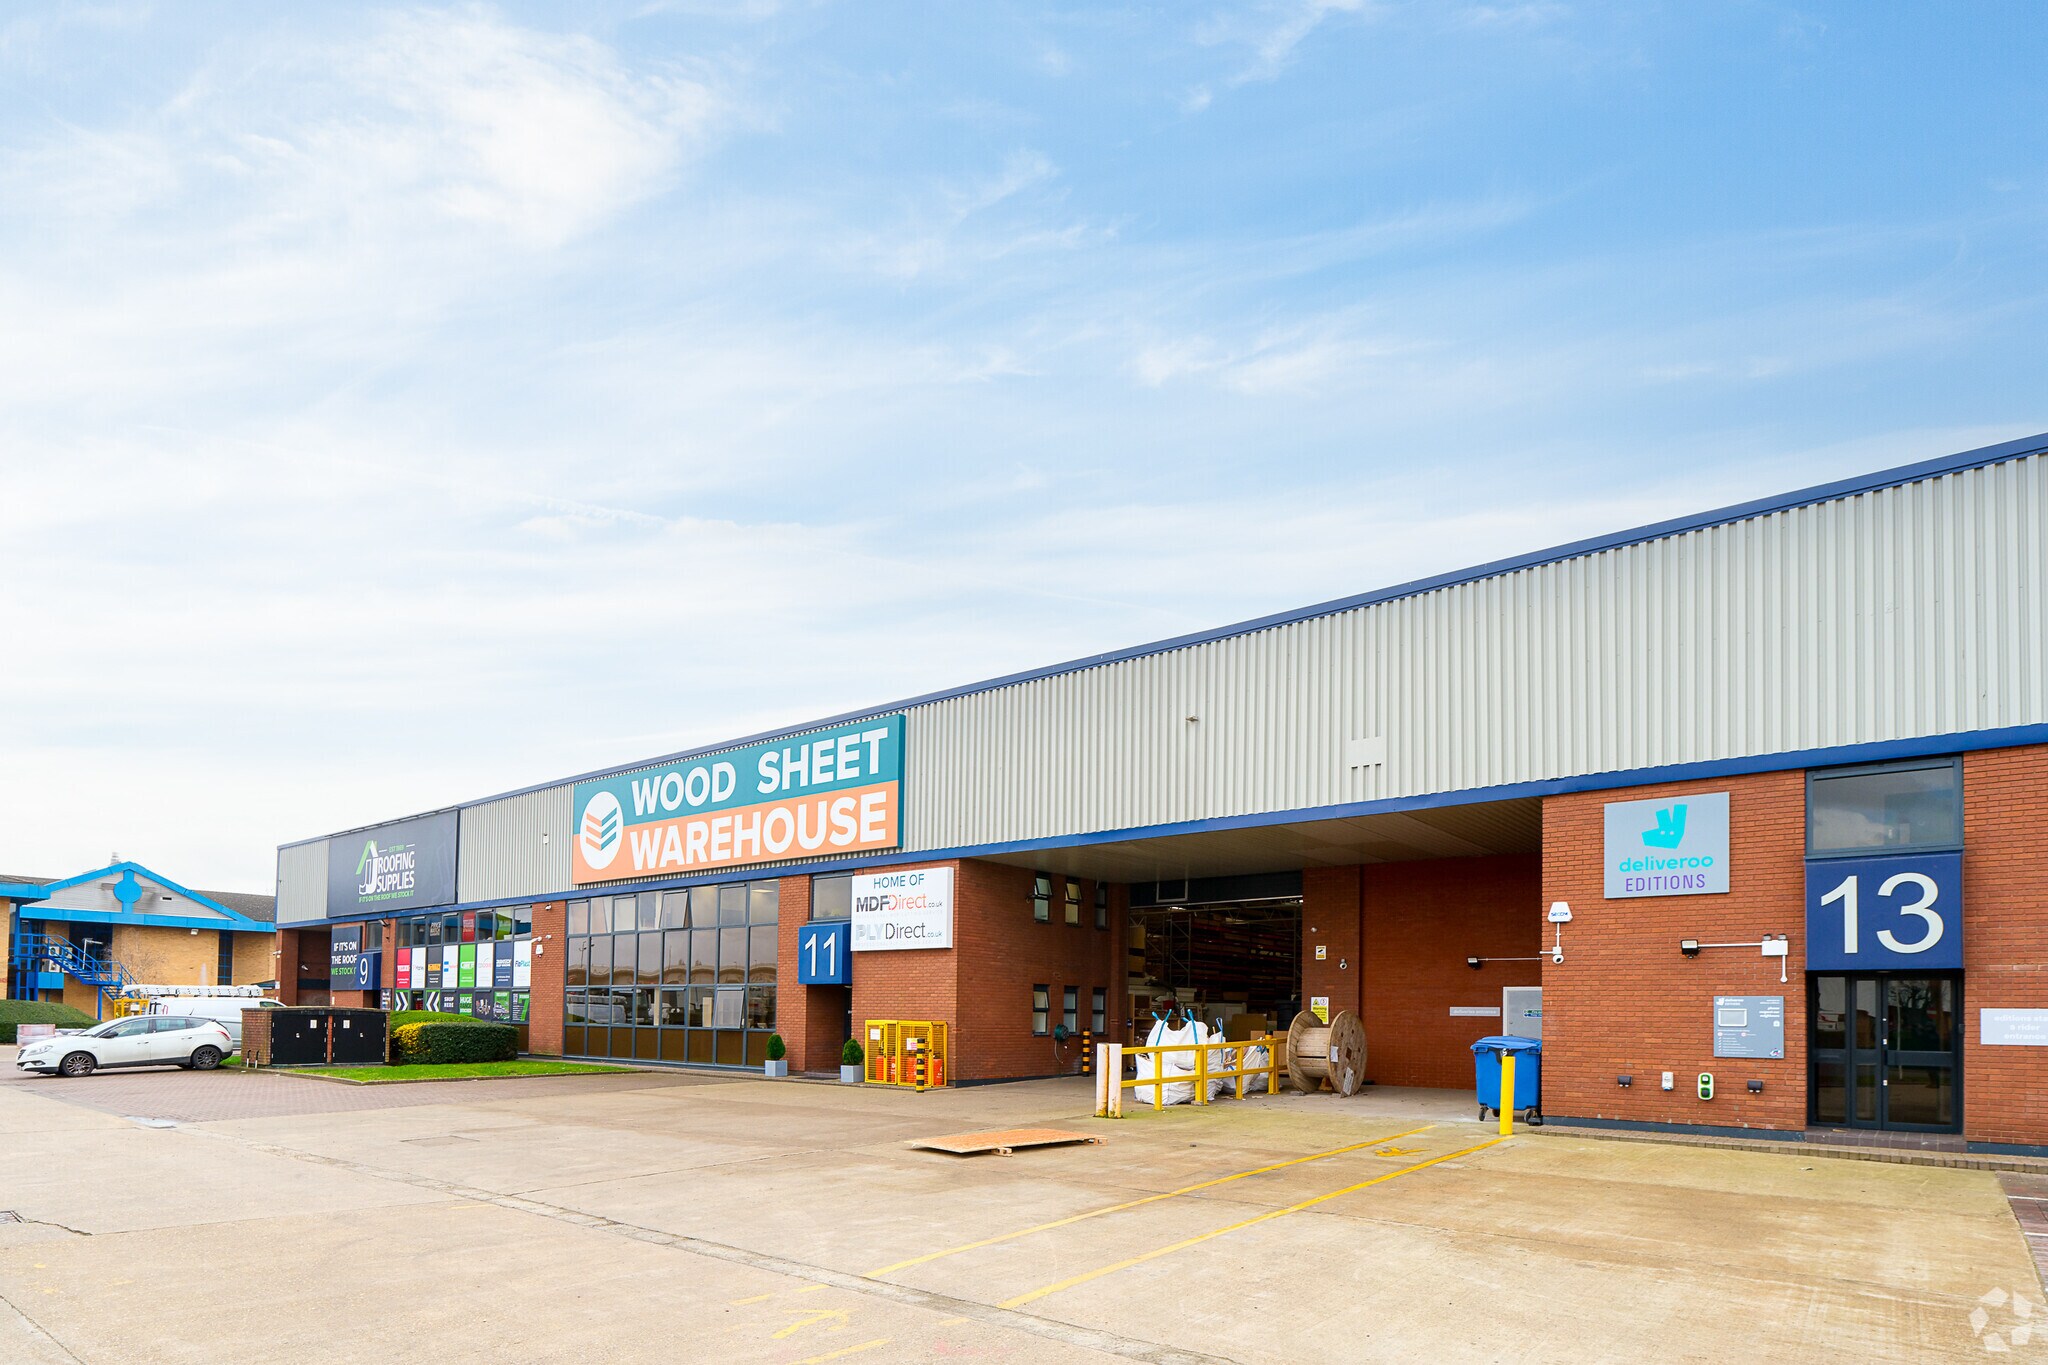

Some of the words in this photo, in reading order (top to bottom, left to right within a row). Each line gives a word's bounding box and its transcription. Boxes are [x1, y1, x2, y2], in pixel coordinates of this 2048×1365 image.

[631, 761, 737, 816] WOOD
[756, 727, 889, 795] SHEET
[630, 790, 888, 871] WAREHOUSE
[378, 851, 415, 874] ROOFING
[1619, 856, 1714, 872] deliveroo
[377, 870, 415, 893] SUPPLIES
[873, 875, 906, 889] HOME
[909, 873, 925, 886] OF
[1625, 873, 1706, 892] EDITIONS
[1821, 872, 1944, 954] 13
[334, 943, 339, 951] IF
[339, 942, 348, 951] IT'S
[349, 941, 357, 951] ON
[805, 932, 836, 977] 11
[331, 955, 341, 964] THE
[342, 954, 357, 964] ROOF
[331, 967, 338, 975] WE
[339, 967, 353, 975] STOCK
[360, 958, 368, 985] 9
